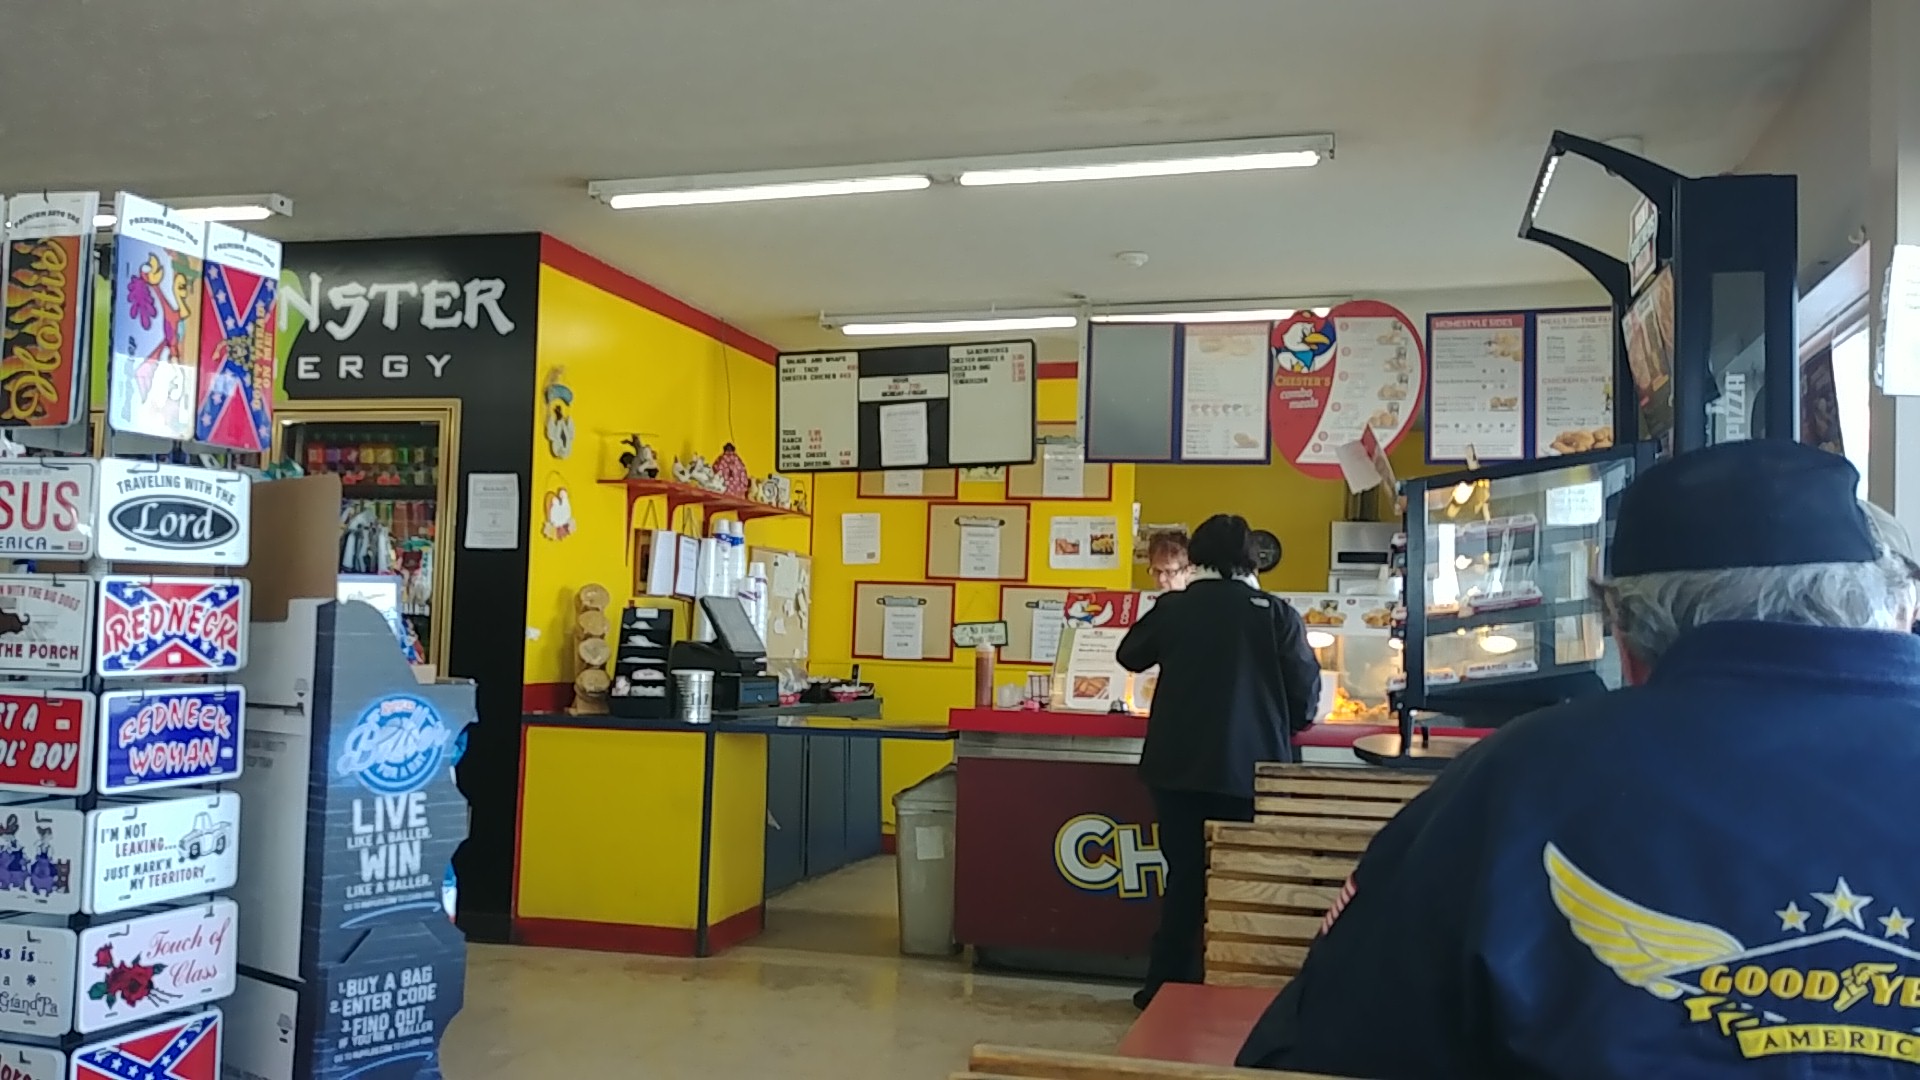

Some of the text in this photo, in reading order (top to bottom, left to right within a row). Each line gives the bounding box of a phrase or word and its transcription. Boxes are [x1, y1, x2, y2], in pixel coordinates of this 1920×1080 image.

[129, 217, 164, 226] PREMIUM
[280, 272, 515, 341] NSTER
[262, 366, 272, 388] ON
[297, 355, 451, 379] ERGY
[1275, 376, 1331, 387] CHESTER'S
[116, 475, 236, 506] TRAVELING WITH THE
[0, 480, 80, 532] SUS
[132, 502, 214, 540] Lord
[0, 536, 47, 550] ERICA
[107, 598, 238, 653] REDNECK
[29, 643, 79, 660] PORCH
[22, 702, 39, 732] A
[29, 741, 78, 771] BOY
[129, 737, 220, 776] WOMAN
[352, 791, 427, 835] LIVE
[100, 822, 147, 844] I'M NOT
[346, 833, 373, 849] LIKE
[375, 832, 385, 845] A
[103, 857, 172, 882] JUST MARK'N
[360, 840, 421, 882] WIN
[1055, 813, 1169, 898] CH
[130, 864, 206, 891] MY TERRITORY
[346, 882, 373, 898] LIKE
[375, 881, 384, 894] A
[147, 917, 231, 959] Touch of
[169, 960, 218, 988] Class
[346, 975, 379, 998] BUY
[384, 972, 397, 991] A
[401, 966, 433, 987] BAG
[1700, 963, 1920, 1008] GOODYE
[342, 991, 392, 1017] ENTER
[397, 983, 437, 1007] CODE
[352, 1012, 390, 1037] FIND
[394, 1005, 426, 1028] OUT
[1763, 1030, 1914, 1057] AMERIC
